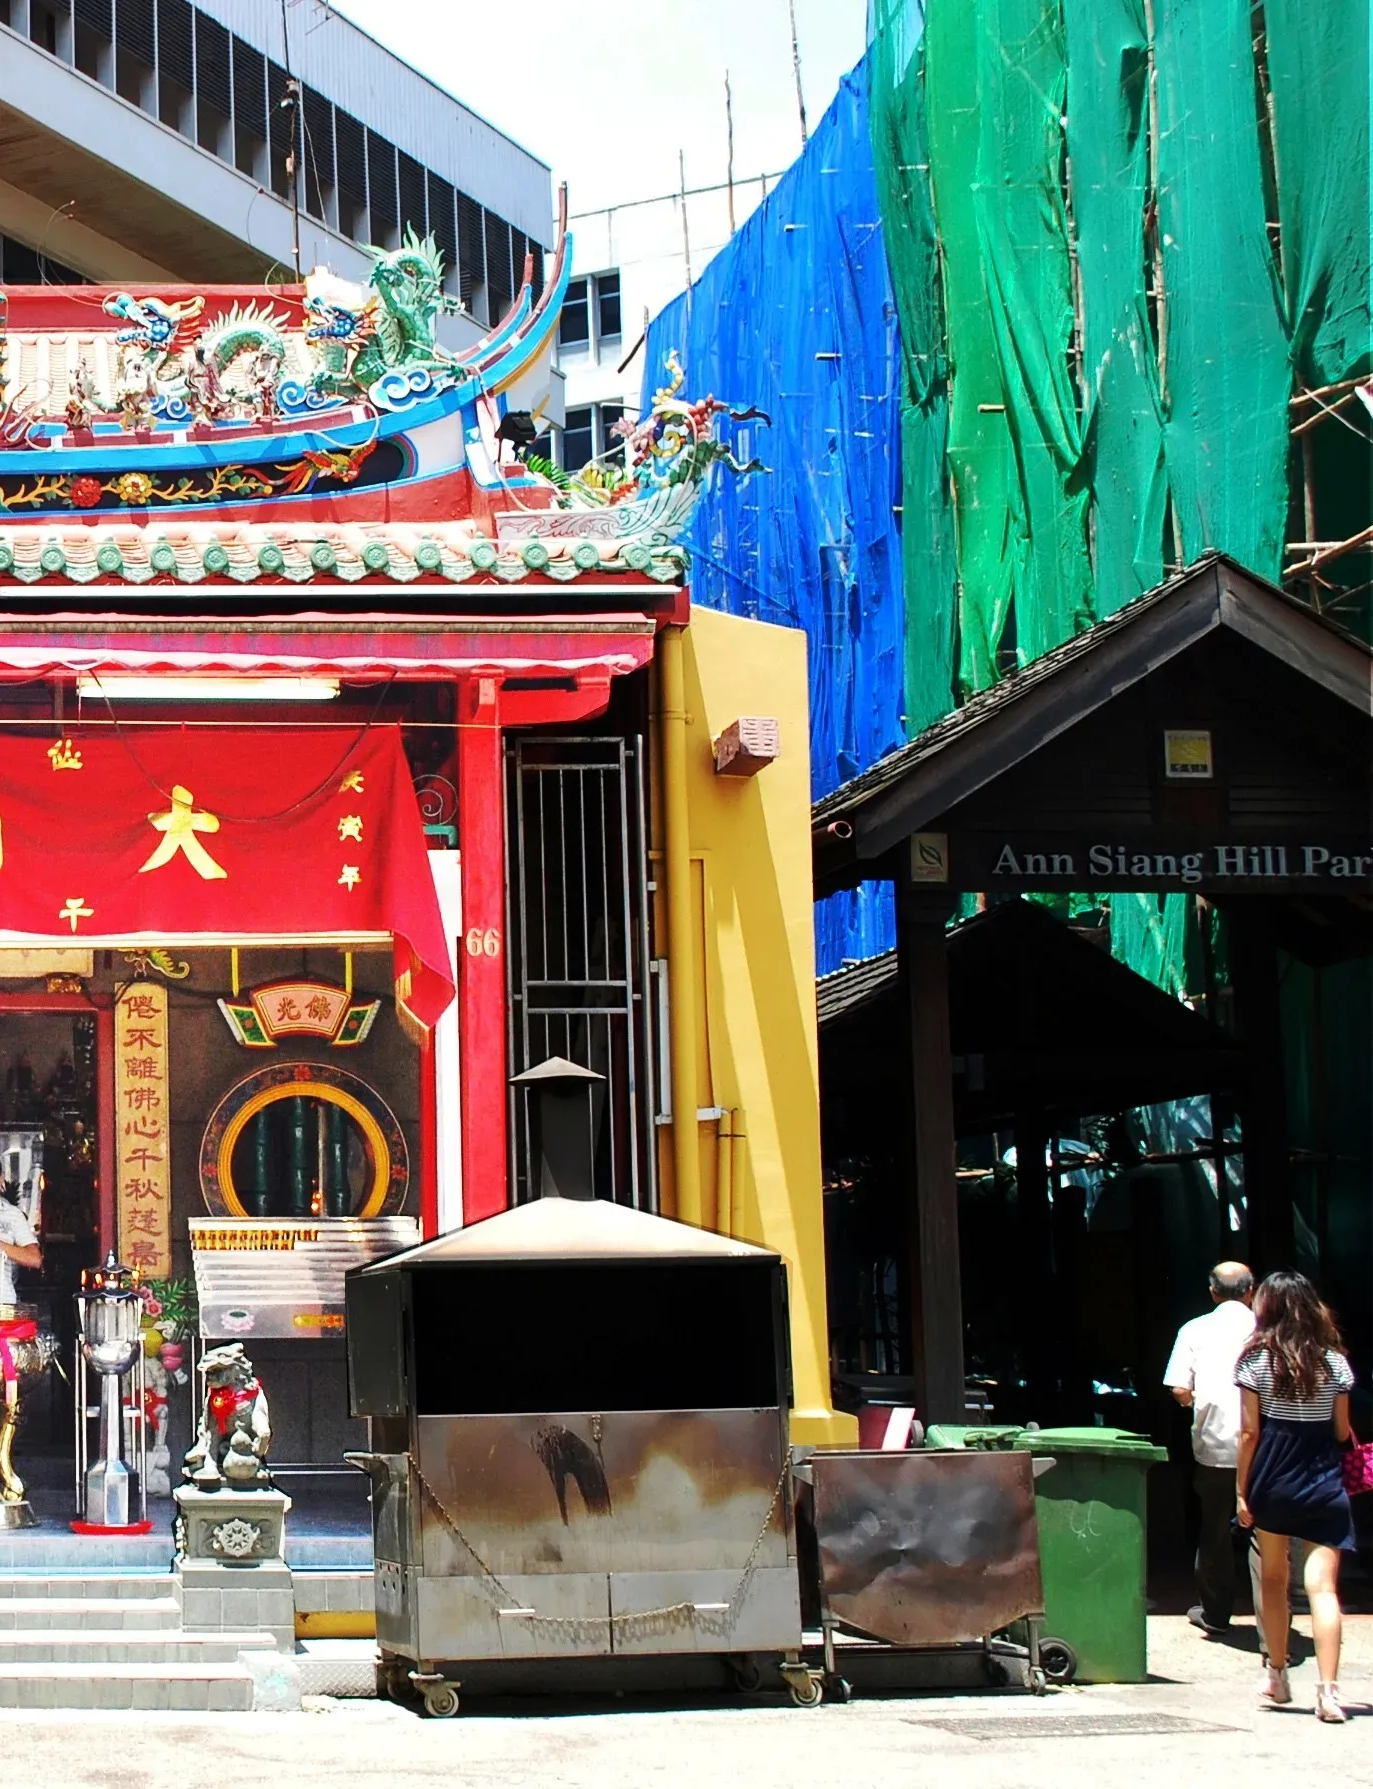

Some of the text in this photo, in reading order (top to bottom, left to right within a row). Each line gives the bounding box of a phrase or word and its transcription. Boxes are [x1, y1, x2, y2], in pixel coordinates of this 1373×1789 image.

[992, 844, 1373, 884] Ann Siang Hill Par
[466, 927, 500, 957] 66
[277, 995, 331, 1022] 佛光
